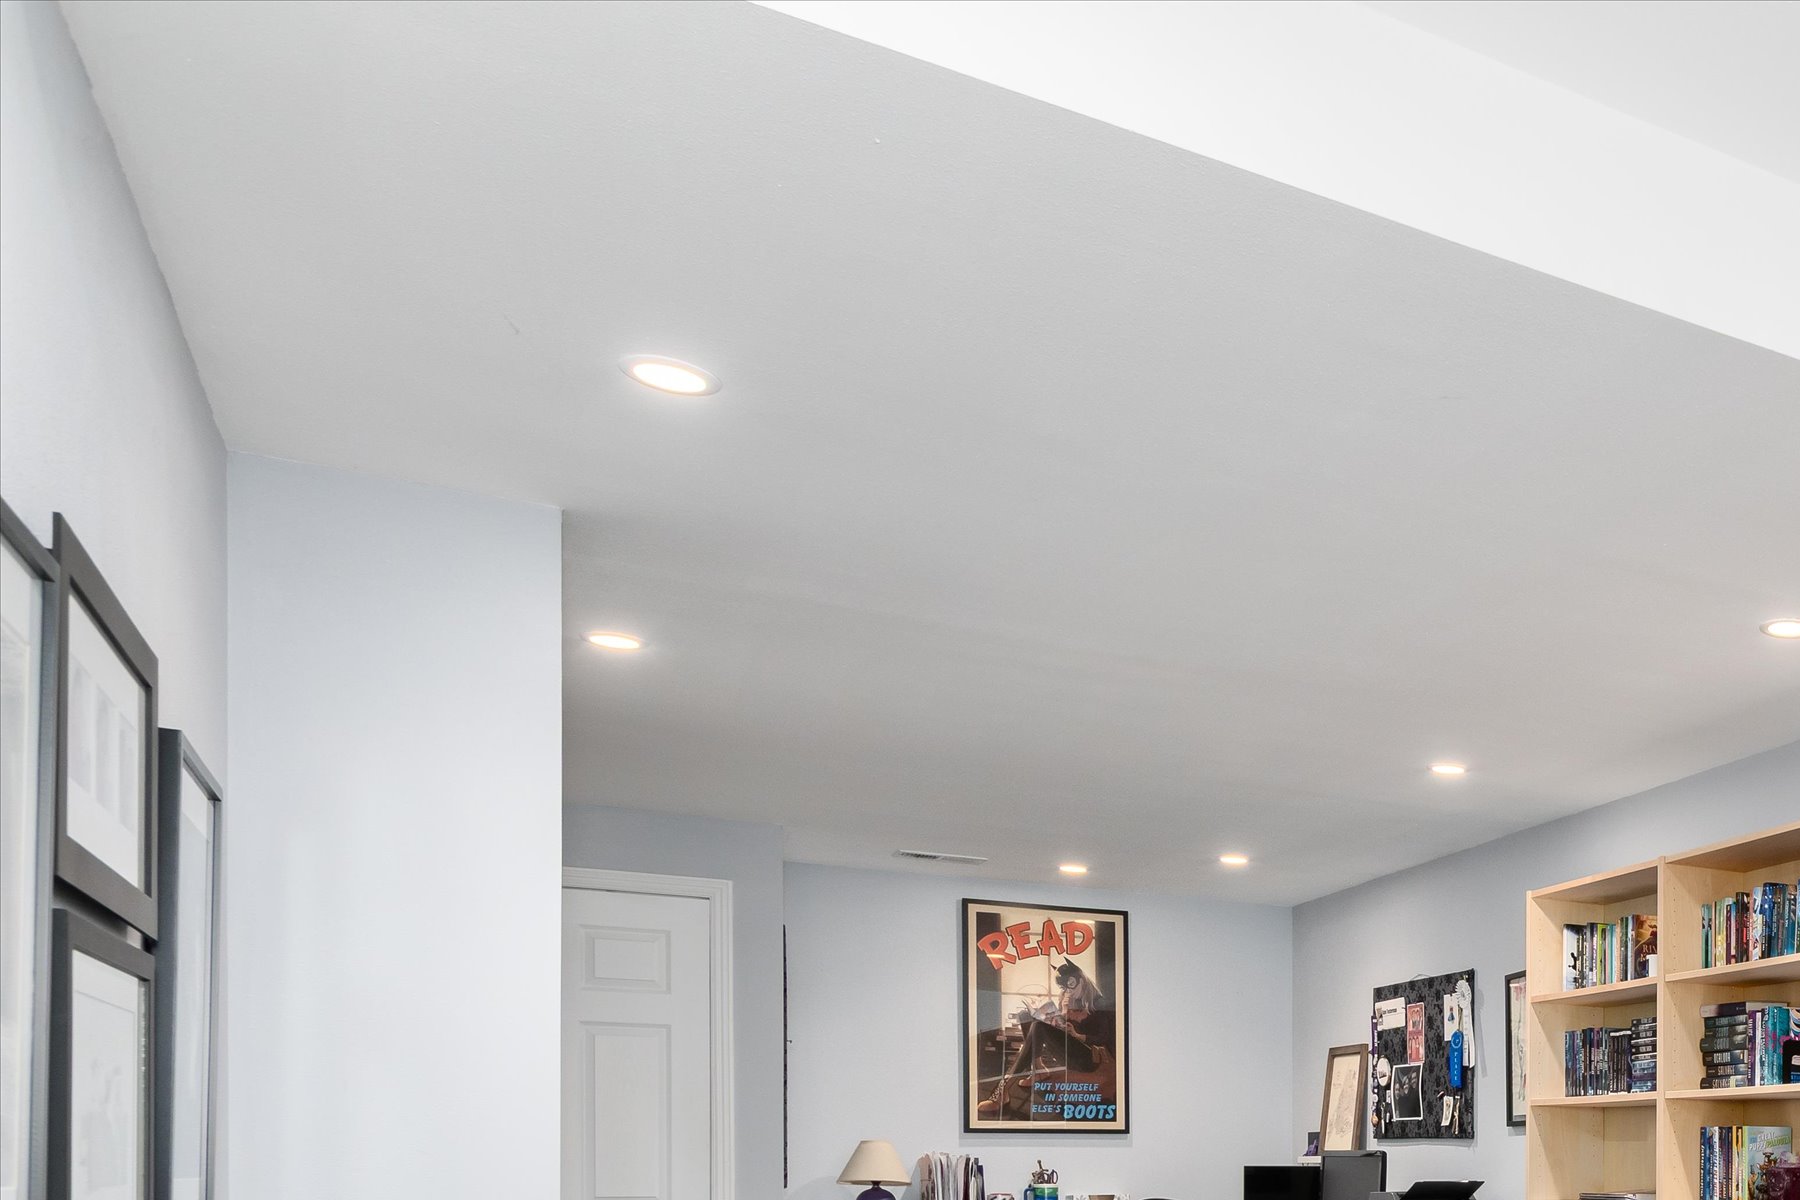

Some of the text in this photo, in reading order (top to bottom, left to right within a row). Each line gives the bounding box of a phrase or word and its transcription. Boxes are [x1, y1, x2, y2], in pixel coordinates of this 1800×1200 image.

[977, 919, 1094, 971] READ
[1034, 1082, 1099, 1091] PUT YOURSELF
[1045, 1093, 1102, 1102] IN SOMEONE
[1032, 1104, 1116, 1120] ELSE'S BOOTS
